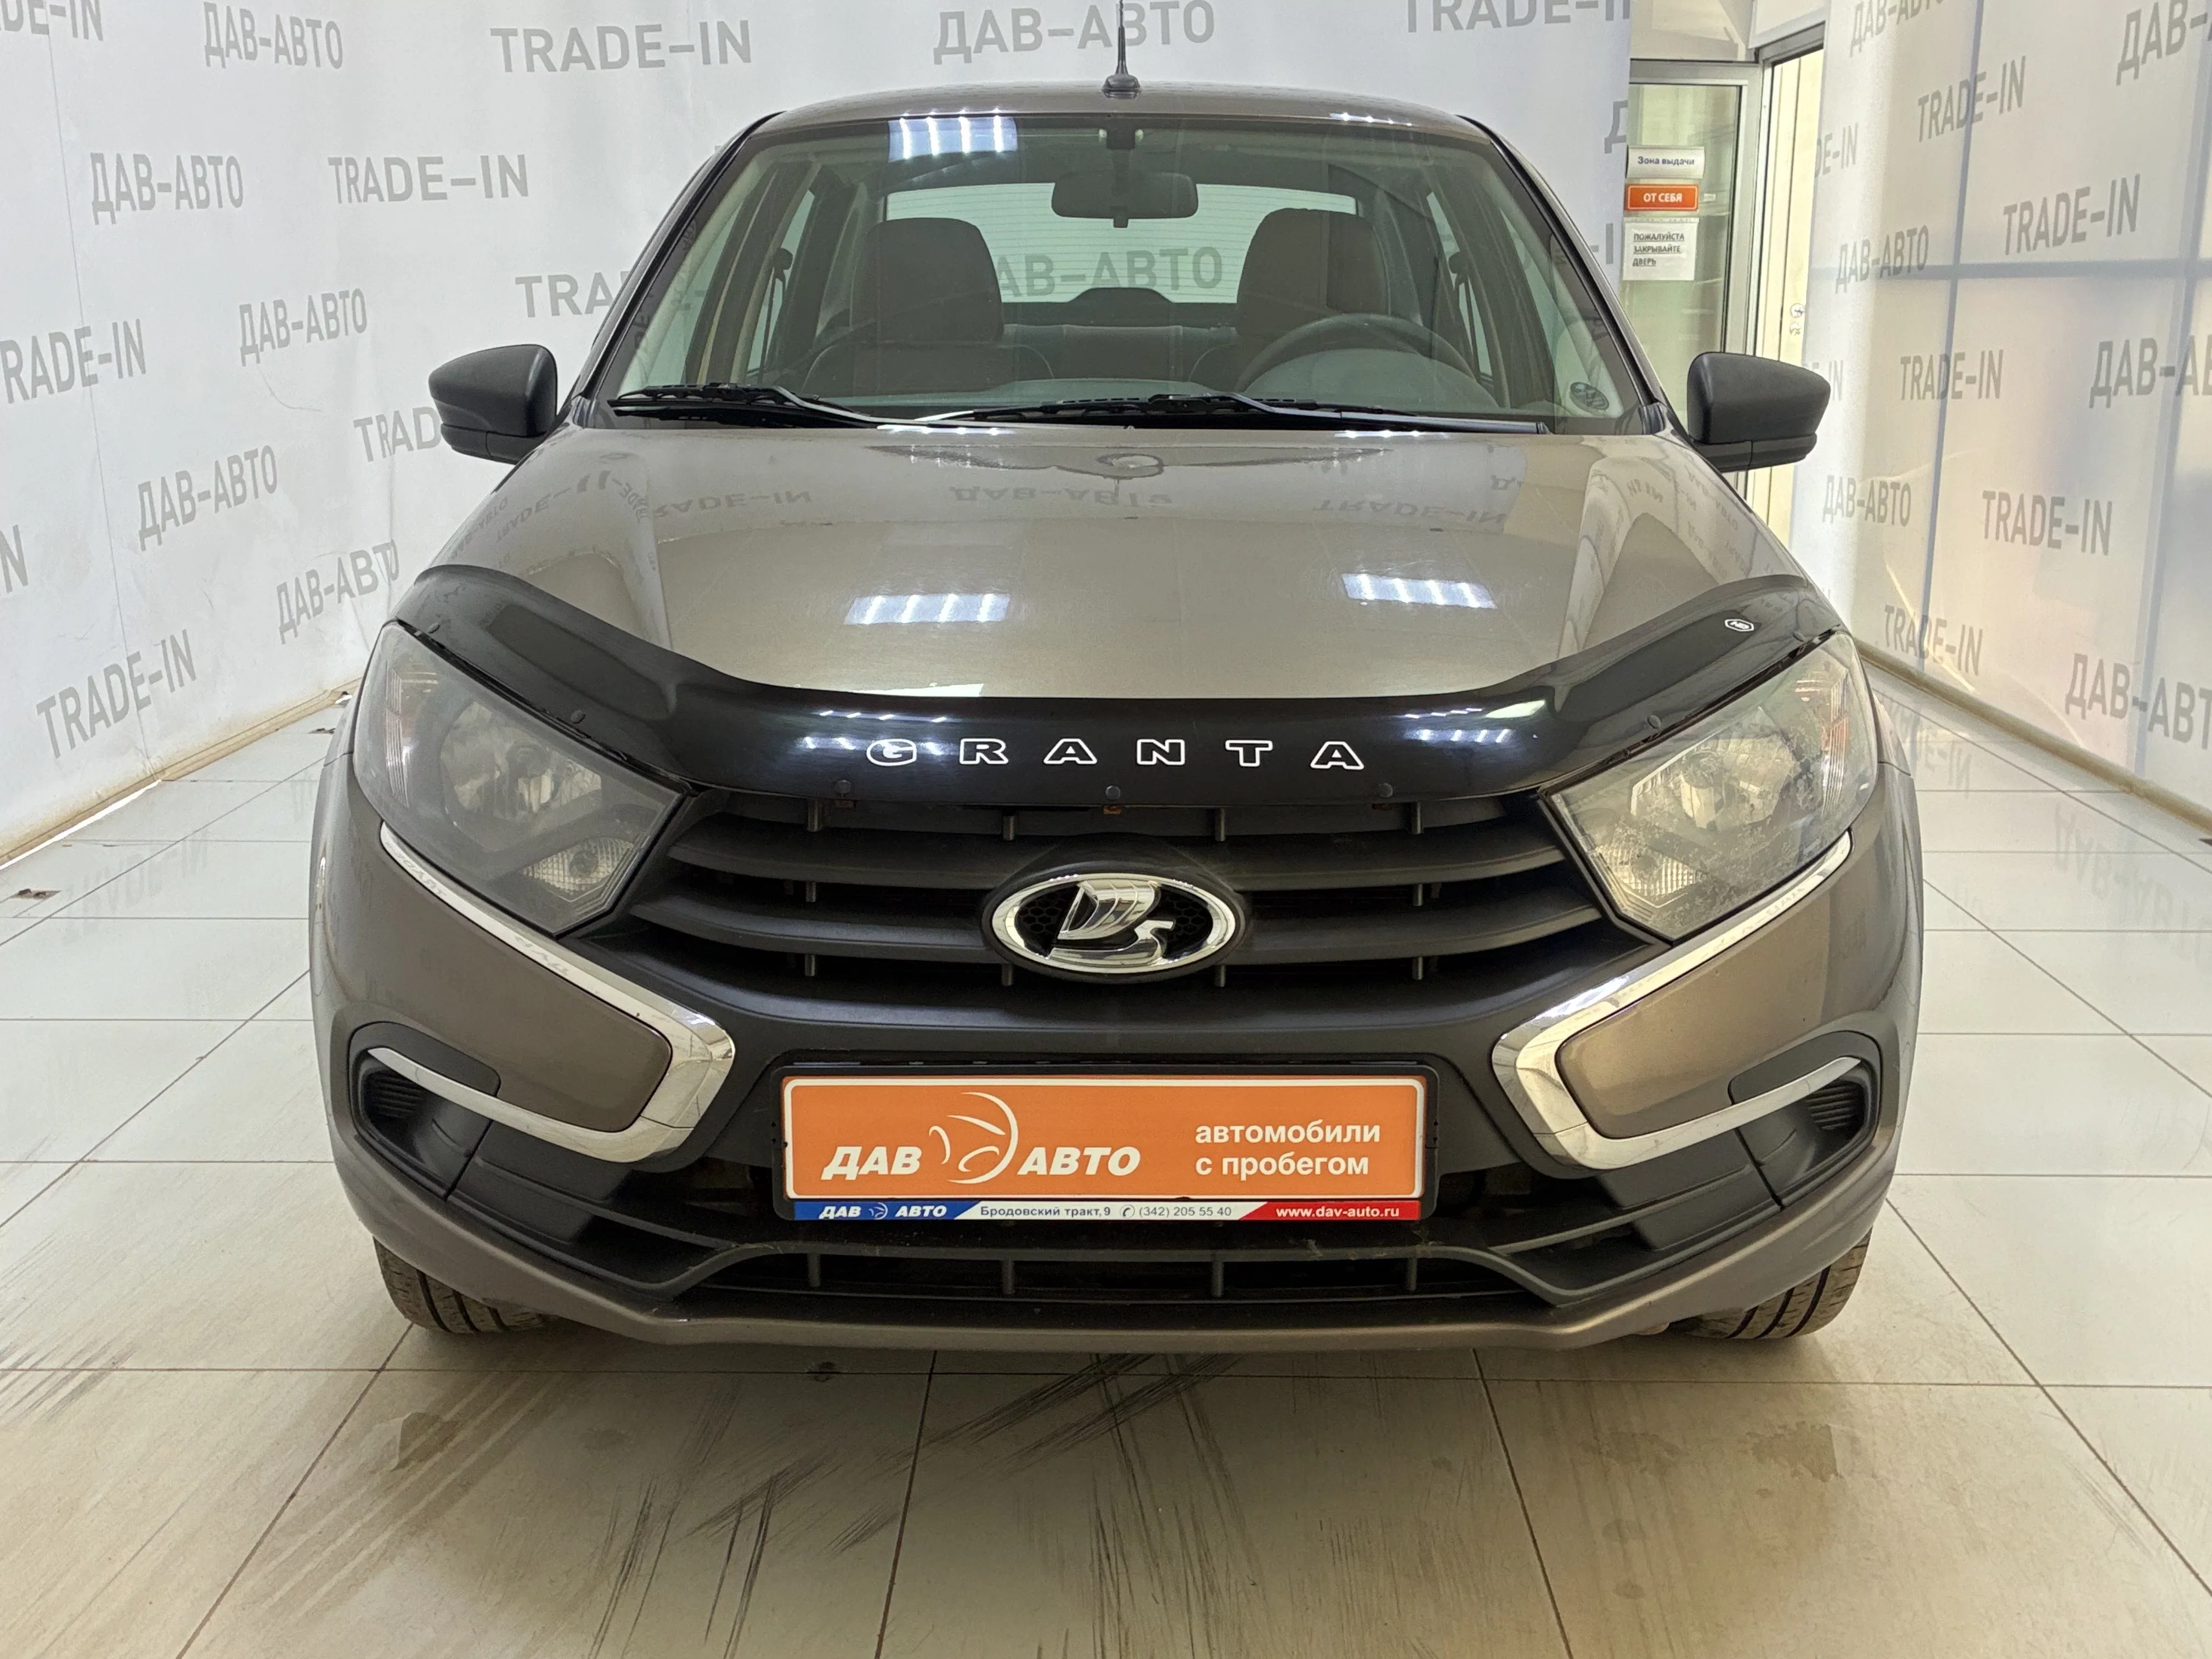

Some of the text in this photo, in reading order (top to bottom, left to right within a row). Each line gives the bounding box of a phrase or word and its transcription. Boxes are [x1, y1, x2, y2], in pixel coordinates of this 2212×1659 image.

[0, 0, 103, 41] DE-IN
[204, 2, 343, 69] ДАВ-АВТО
[490, 20, 752, 72] TRADE-IN
[933, 0, 1214, 65] ДАВ-АВТО
[2116, 0, 2212, 86] ДАВ-
[1918, 56, 2026, 142] TRADE-IN
[328, 154, 528, 204] TRADE-IN
[1638, 156, 1660, 164] Зона
[90, 153, 244, 225] ДАВ-АВТО
[1643, 193, 1683, 202] ОТ СЕБЯ
[2004, 174, 2140, 255] TRADE-IN
[1633, 244, 1680, 252] ЗАКРЫВАЙТЕ
[1634, 232, 1684, 241] ПОЖАЛУЙСТА
[1836, 225, 1929, 294] ДАВ-АВТО
[1633, 258, 1656, 267] ДВЕРЬ
[515, 271, 631, 318] TRA
[239, 289, 367, 366] ДАВ-АВТО
[1900, 349, 2004, 400] TRADE-IN
[138, 445, 278, 551] ДАВ-АВТО
[1822, 475, 1911, 526] ДАВ-АВТО
[1982, 490, 2112, 556] TRADE-IN
[276, 538, 400, 645] ДАВ-АВТО
[1884, 605, 1983, 676] TRADE-IN
[36, 629, 196, 759] TRADE-IN
[866, 738, 1364, 770] GRANTA
[1195, 1119, 1380, 1143] автомобили
[821, 1146, 1141, 1180] ДАВ АВТО
[1195, 1152, 1369, 1181] с пробегом
[819, 1206, 861, 1220] ДАВ
[895, 1205, 947, 1217] АВТО
[981, 1206, 1060, 1217] Бродовский
[1139, 1206, 1170, 1217] (342)
[1173, 1206, 1195, 1216] 205
[1199, 1206, 1214, 1216] 55
[1217, 1206, 1232, 1216] 40
[1276, 1206, 1400, 1217] www.dav-auto.ru
